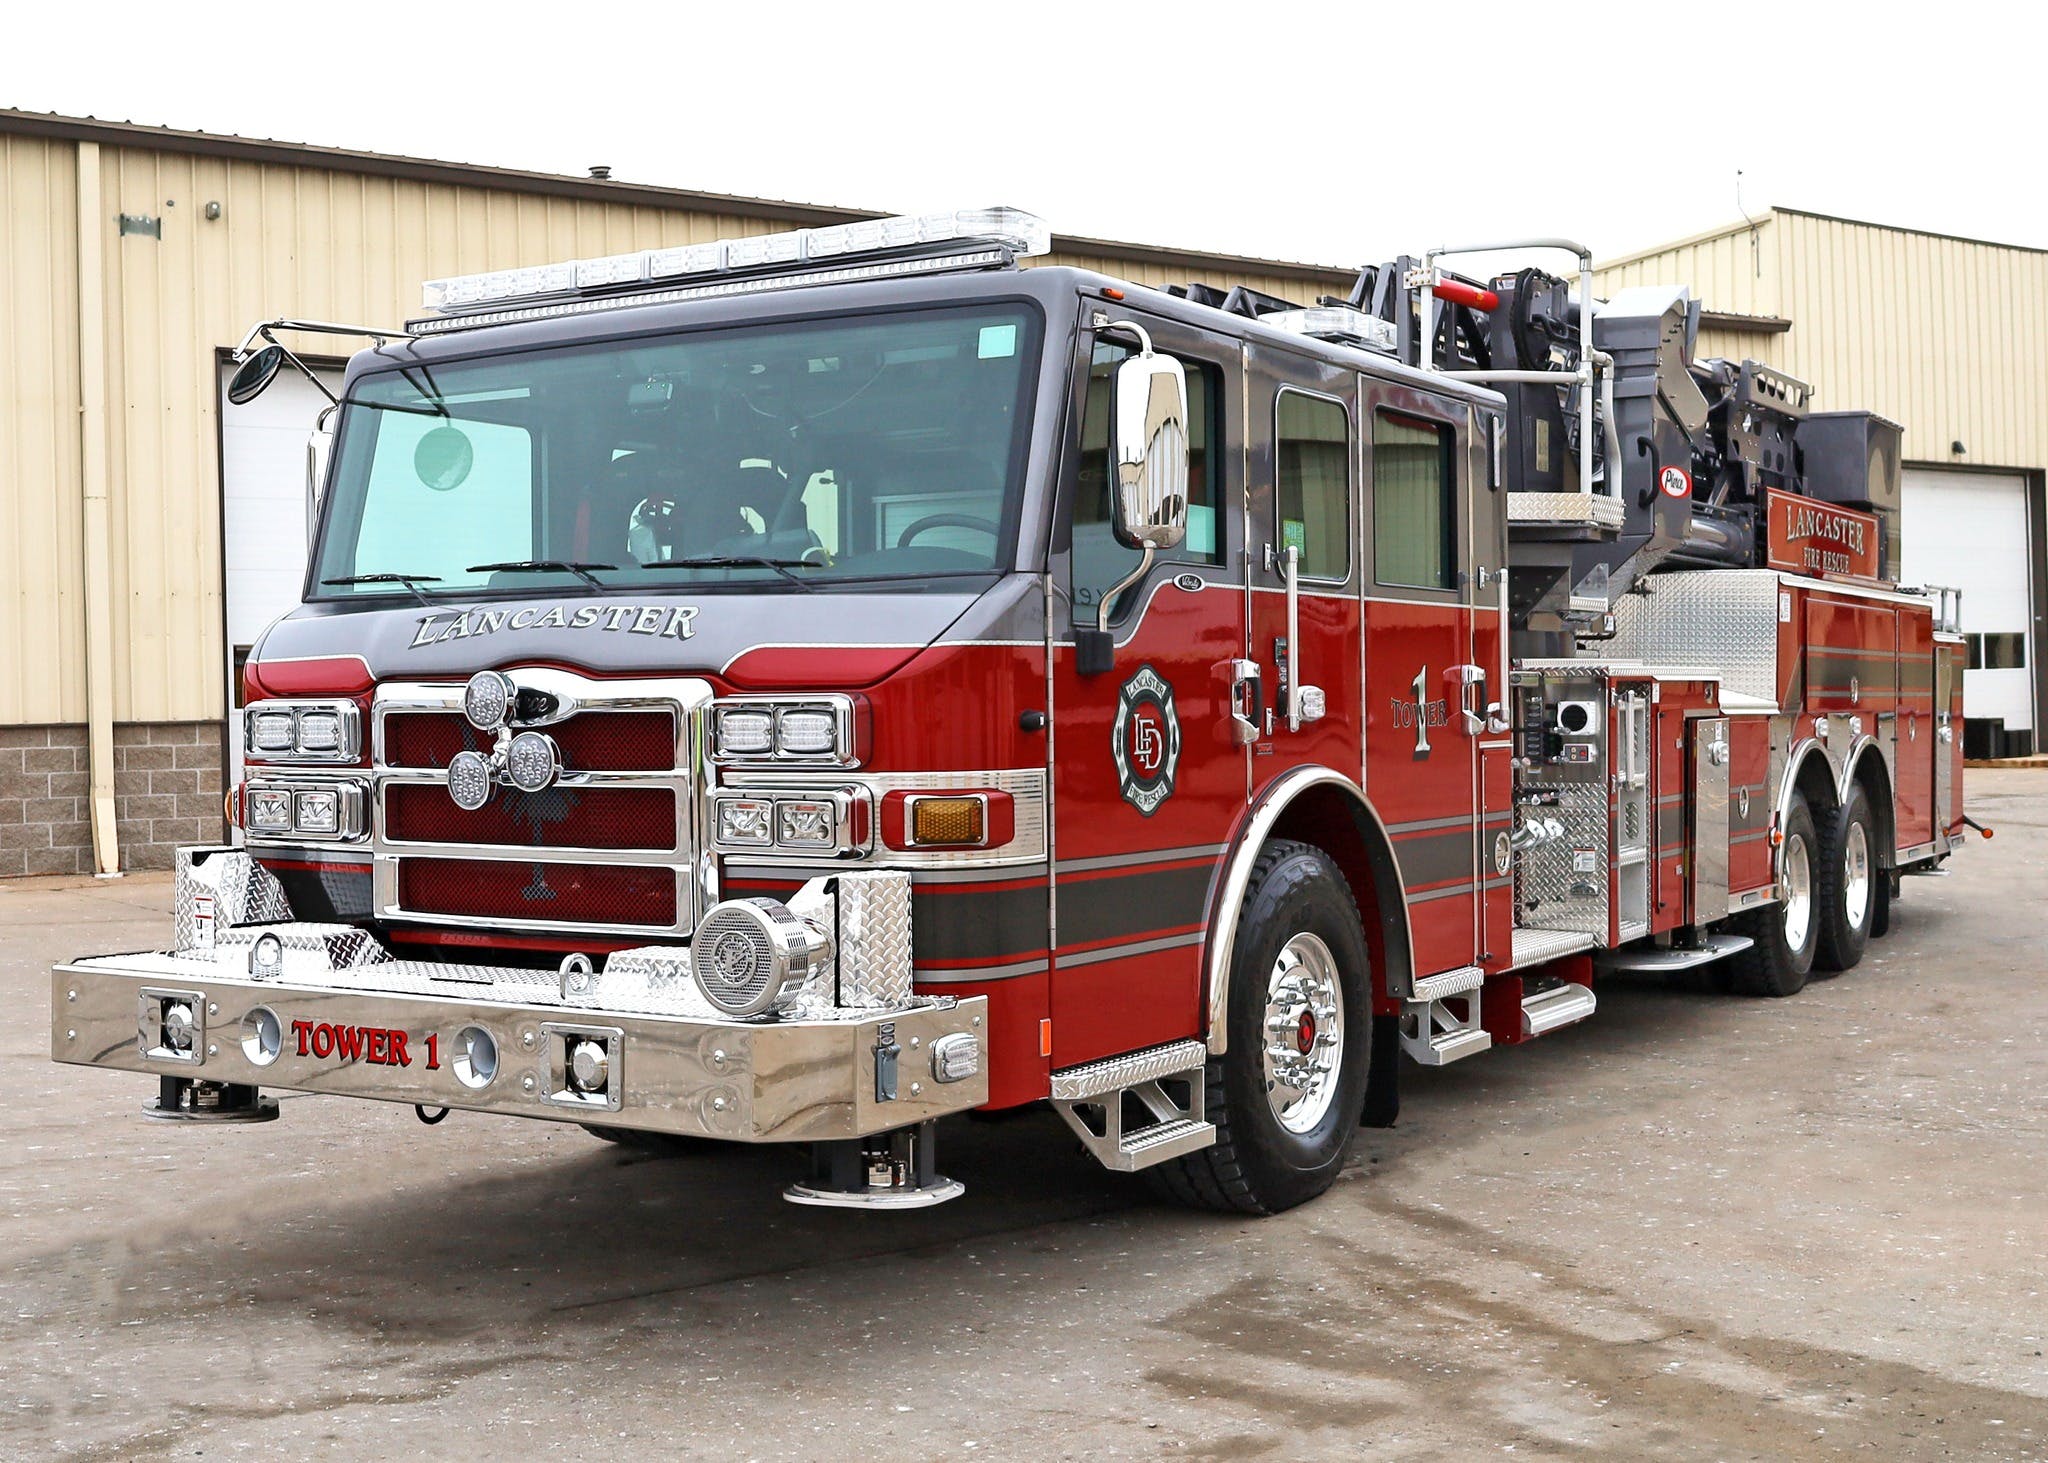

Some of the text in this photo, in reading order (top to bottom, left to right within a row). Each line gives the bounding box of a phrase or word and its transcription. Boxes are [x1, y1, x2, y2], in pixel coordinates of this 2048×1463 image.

[1786, 505, 1865, 556] LANCASTER
[1803, 547, 1849, 574] FIRE RESCUE
[408, 604, 701, 650] LANCASTER
[1128, 676, 1164, 697] LANCASTER
[1391, 697, 1448, 728] TOWER
[1410, 665, 1431, 761] 1
[1129, 783, 1166, 805] FIRE RESCUE
[292, 1020, 441, 1070] TOWER 1
